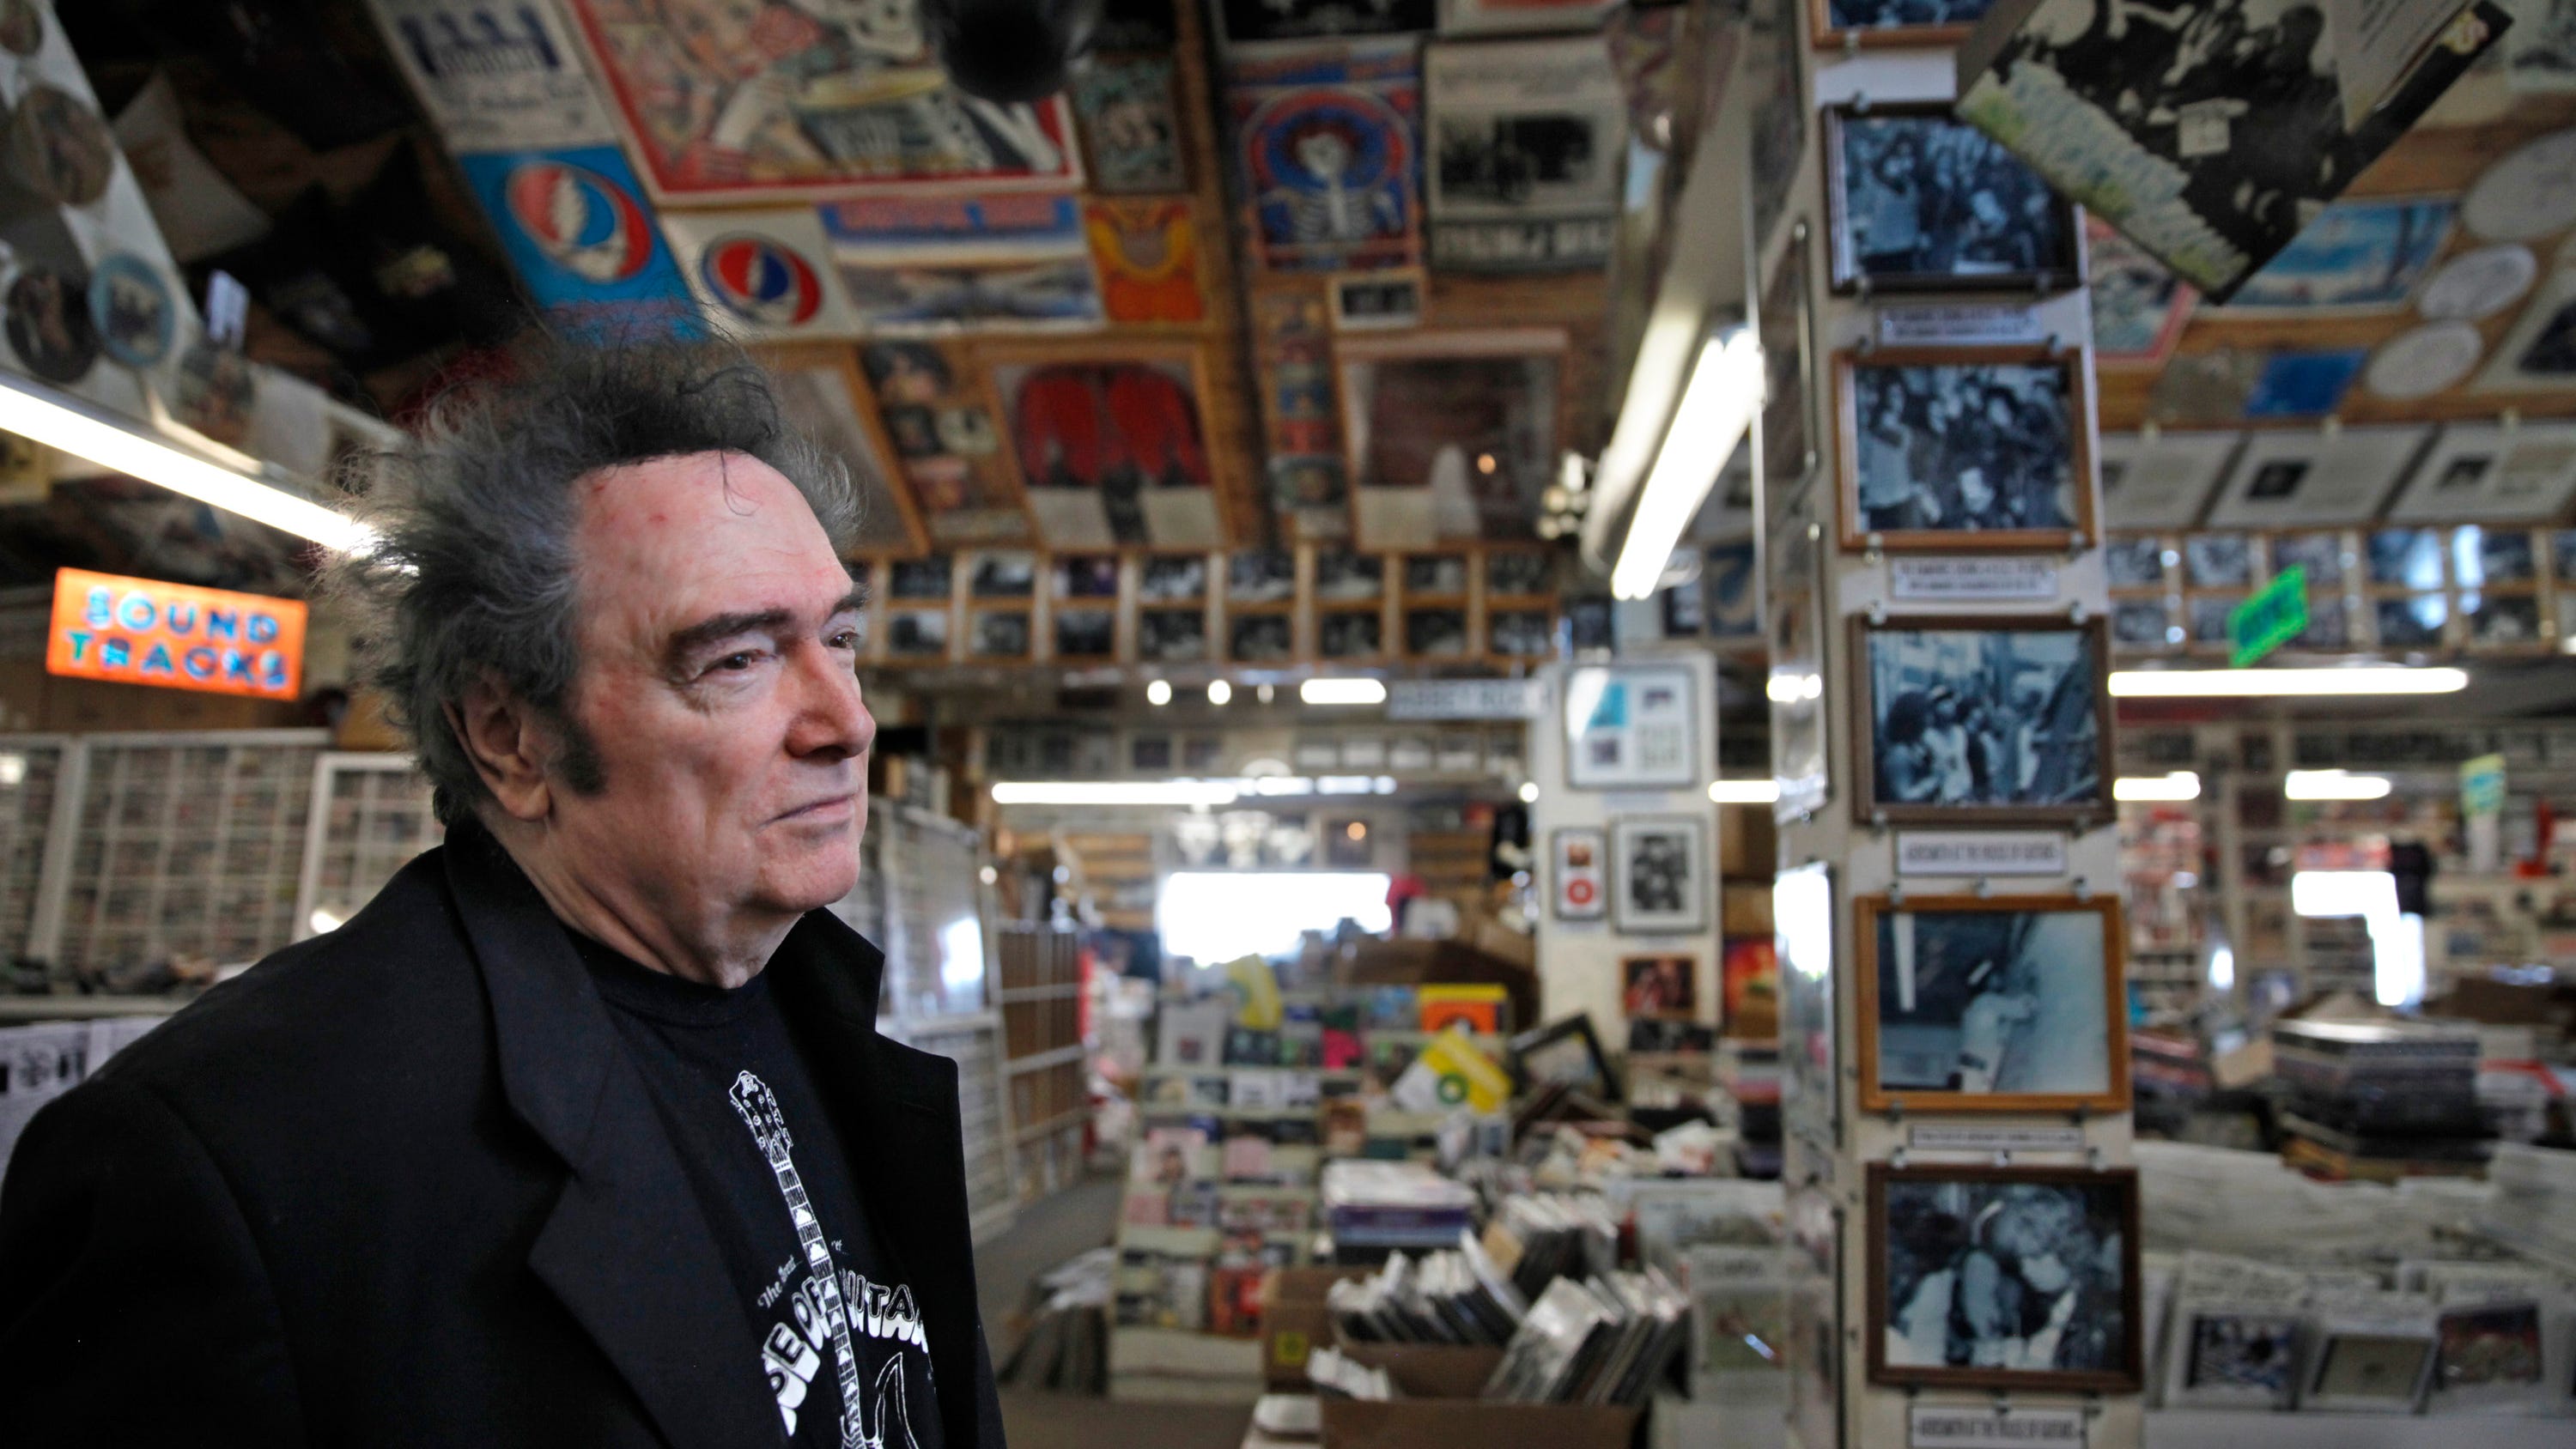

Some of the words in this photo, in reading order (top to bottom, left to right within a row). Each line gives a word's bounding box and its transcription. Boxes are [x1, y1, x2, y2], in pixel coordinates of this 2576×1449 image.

[86, 586, 279, 644] SOUND
[68, 632, 287, 689] TRACKS
[757, 1282, 783, 1308] The
